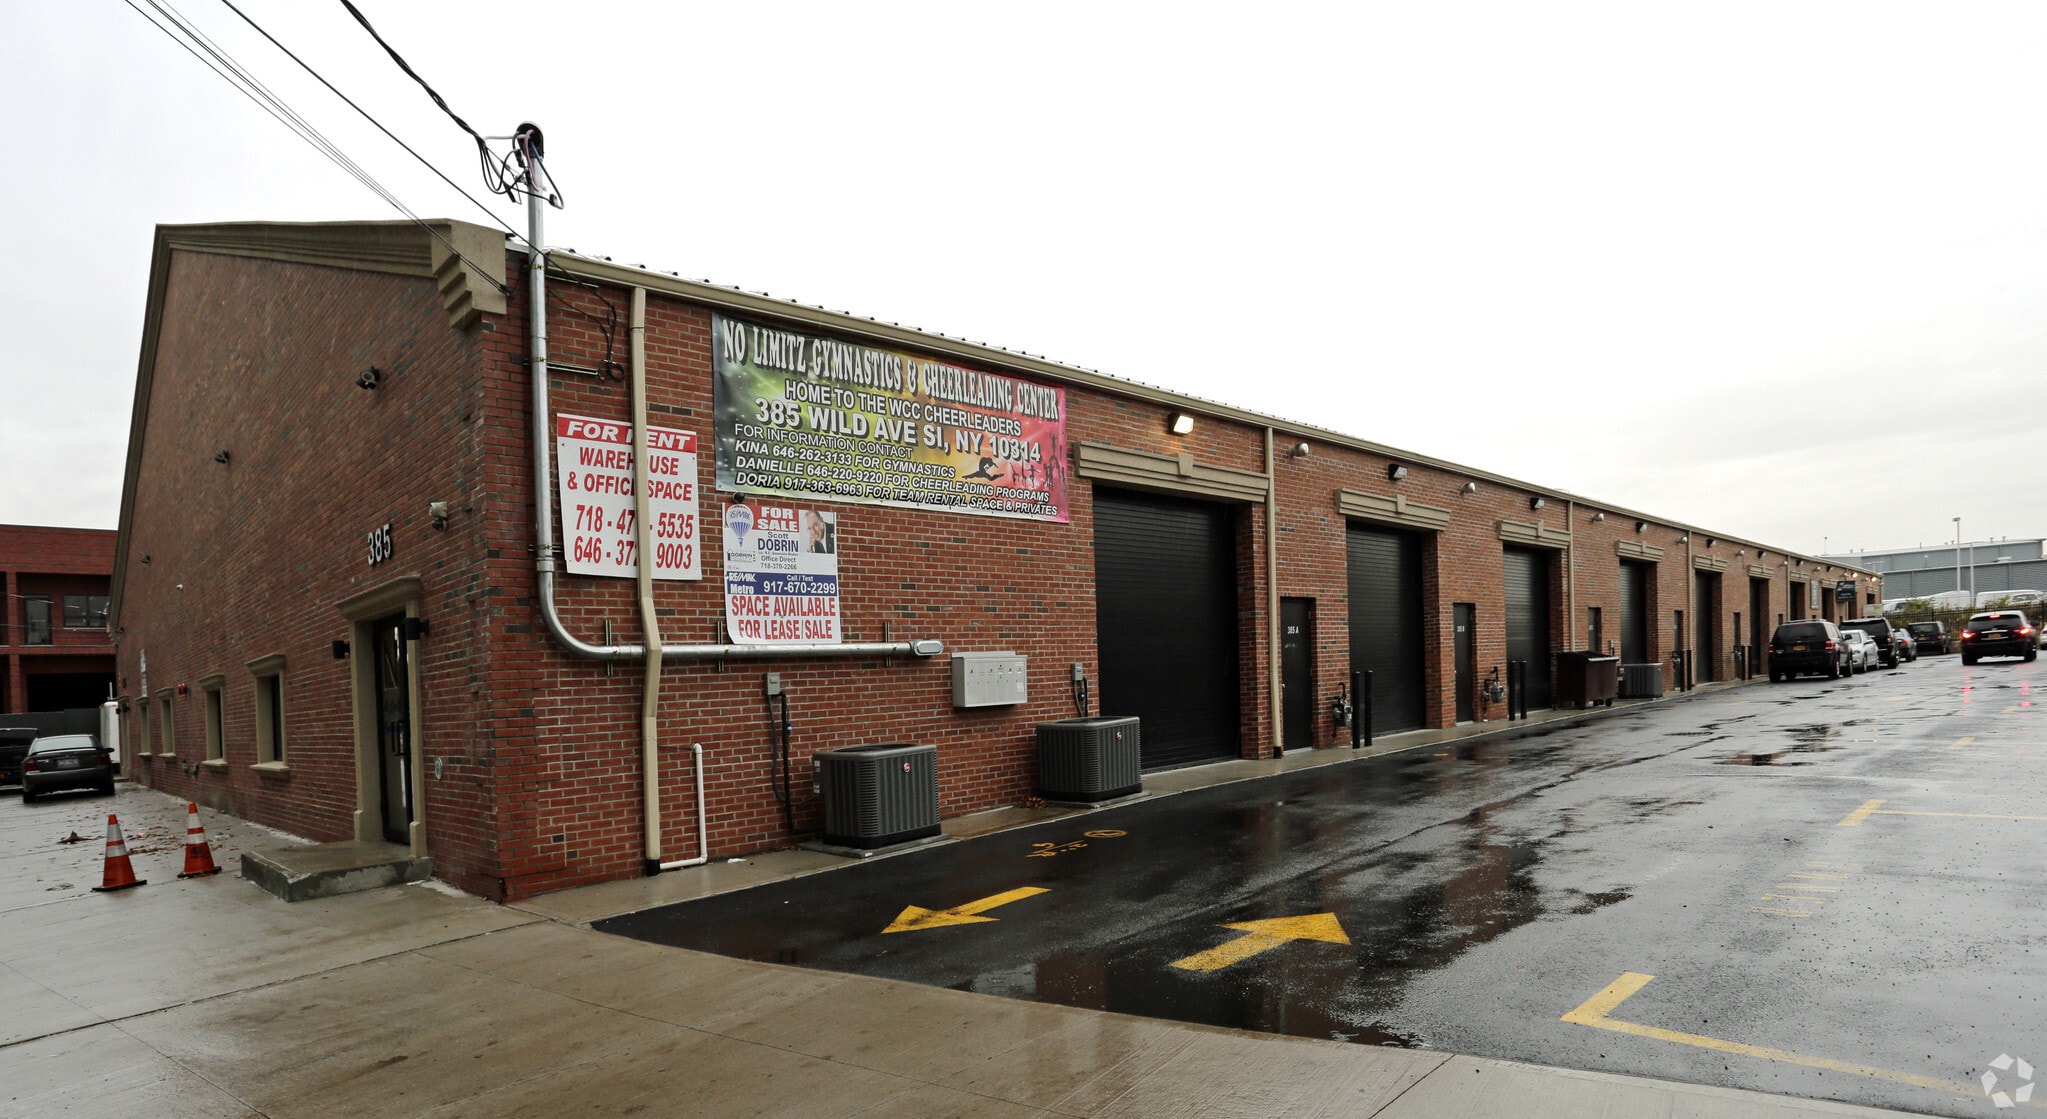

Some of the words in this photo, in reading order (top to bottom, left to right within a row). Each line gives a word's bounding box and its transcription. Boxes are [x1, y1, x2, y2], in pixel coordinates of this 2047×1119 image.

[722, 319, 746, 362] NO
[753, 326, 806, 373] LIMITZ
[812, 338, 901, 391] GYMNASTICS
[907, 358, 917, 394] &
[923, 362, 1012, 413] CHEERLEADING
[1017, 382, 1059, 420] CENTER
[786, 379, 831, 405] HOME
[834, 387, 855, 409] TO
[857, 392, 886, 414] THE
[889, 397, 921, 418] WCC
[924, 405, 1021, 436] CHEERLEADERS
[566, 420, 619, 442] FOR
[734, 423, 763, 439] FOR
[767, 428, 855, 451] INFORMATION
[858, 440, 912, 459] CONTACT
[755, 397, 800, 427] 385
[807, 405, 867, 436] WILD
[874, 416, 917, 444] AVE
[923, 425, 949, 452] SI,
[955, 429, 982, 453] NY
[988, 435, 1041, 462] 10314
[579, 446, 679, 476] WAREHUSE
[735, 440, 769, 455] KINA
[772, 444, 851, 466] 646-262-3133
[855, 455, 880, 469] FOR
[882, 459, 955, 478] GYMNASTICS
[567, 471, 577, 490] &
[647, 479, 693, 502] SPACE
[736, 456, 804, 475] DANIELLE
[807, 464, 882, 484] 646-220-9220
[885, 470, 910, 487] FOR
[912, 476, 994, 496] CHEERLEADING
[996, 487, 1049, 503] PROGRAMS
[736, 472, 780, 488] DORIA
[784, 477, 863, 496] 917-363-6963
[865, 486, 891, 499] FOR
[893, 489, 925, 503] TEAM
[927, 492, 968, 508] RENTAL
[970, 497, 1003, 511] SPACE
[1006, 502, 1012, 512] &
[1014, 502, 1058, 516] PRIVATES
[575, 504, 604, 532] 718
[616, 508, 636, 535] 47
[657, 512, 694, 539] 5535
[757, 518, 798, 532] SALE
[761, 506, 794, 520] FOR
[367, 523, 391, 566] 385
[757, 538, 799, 552] DOBRIN
[767, 532, 789, 540] Scott
[574, 535, 602, 564] 646
[656, 542, 693, 570] 9003
[761, 555, 778, 563] Office
[730, 583, 755, 595] Metro
[763, 580, 836, 594] 917-670-2299
[731, 595, 770, 617] SPACE
[773, 596, 836, 617] AVAILABLE
[738, 619, 761, 639] FOR
